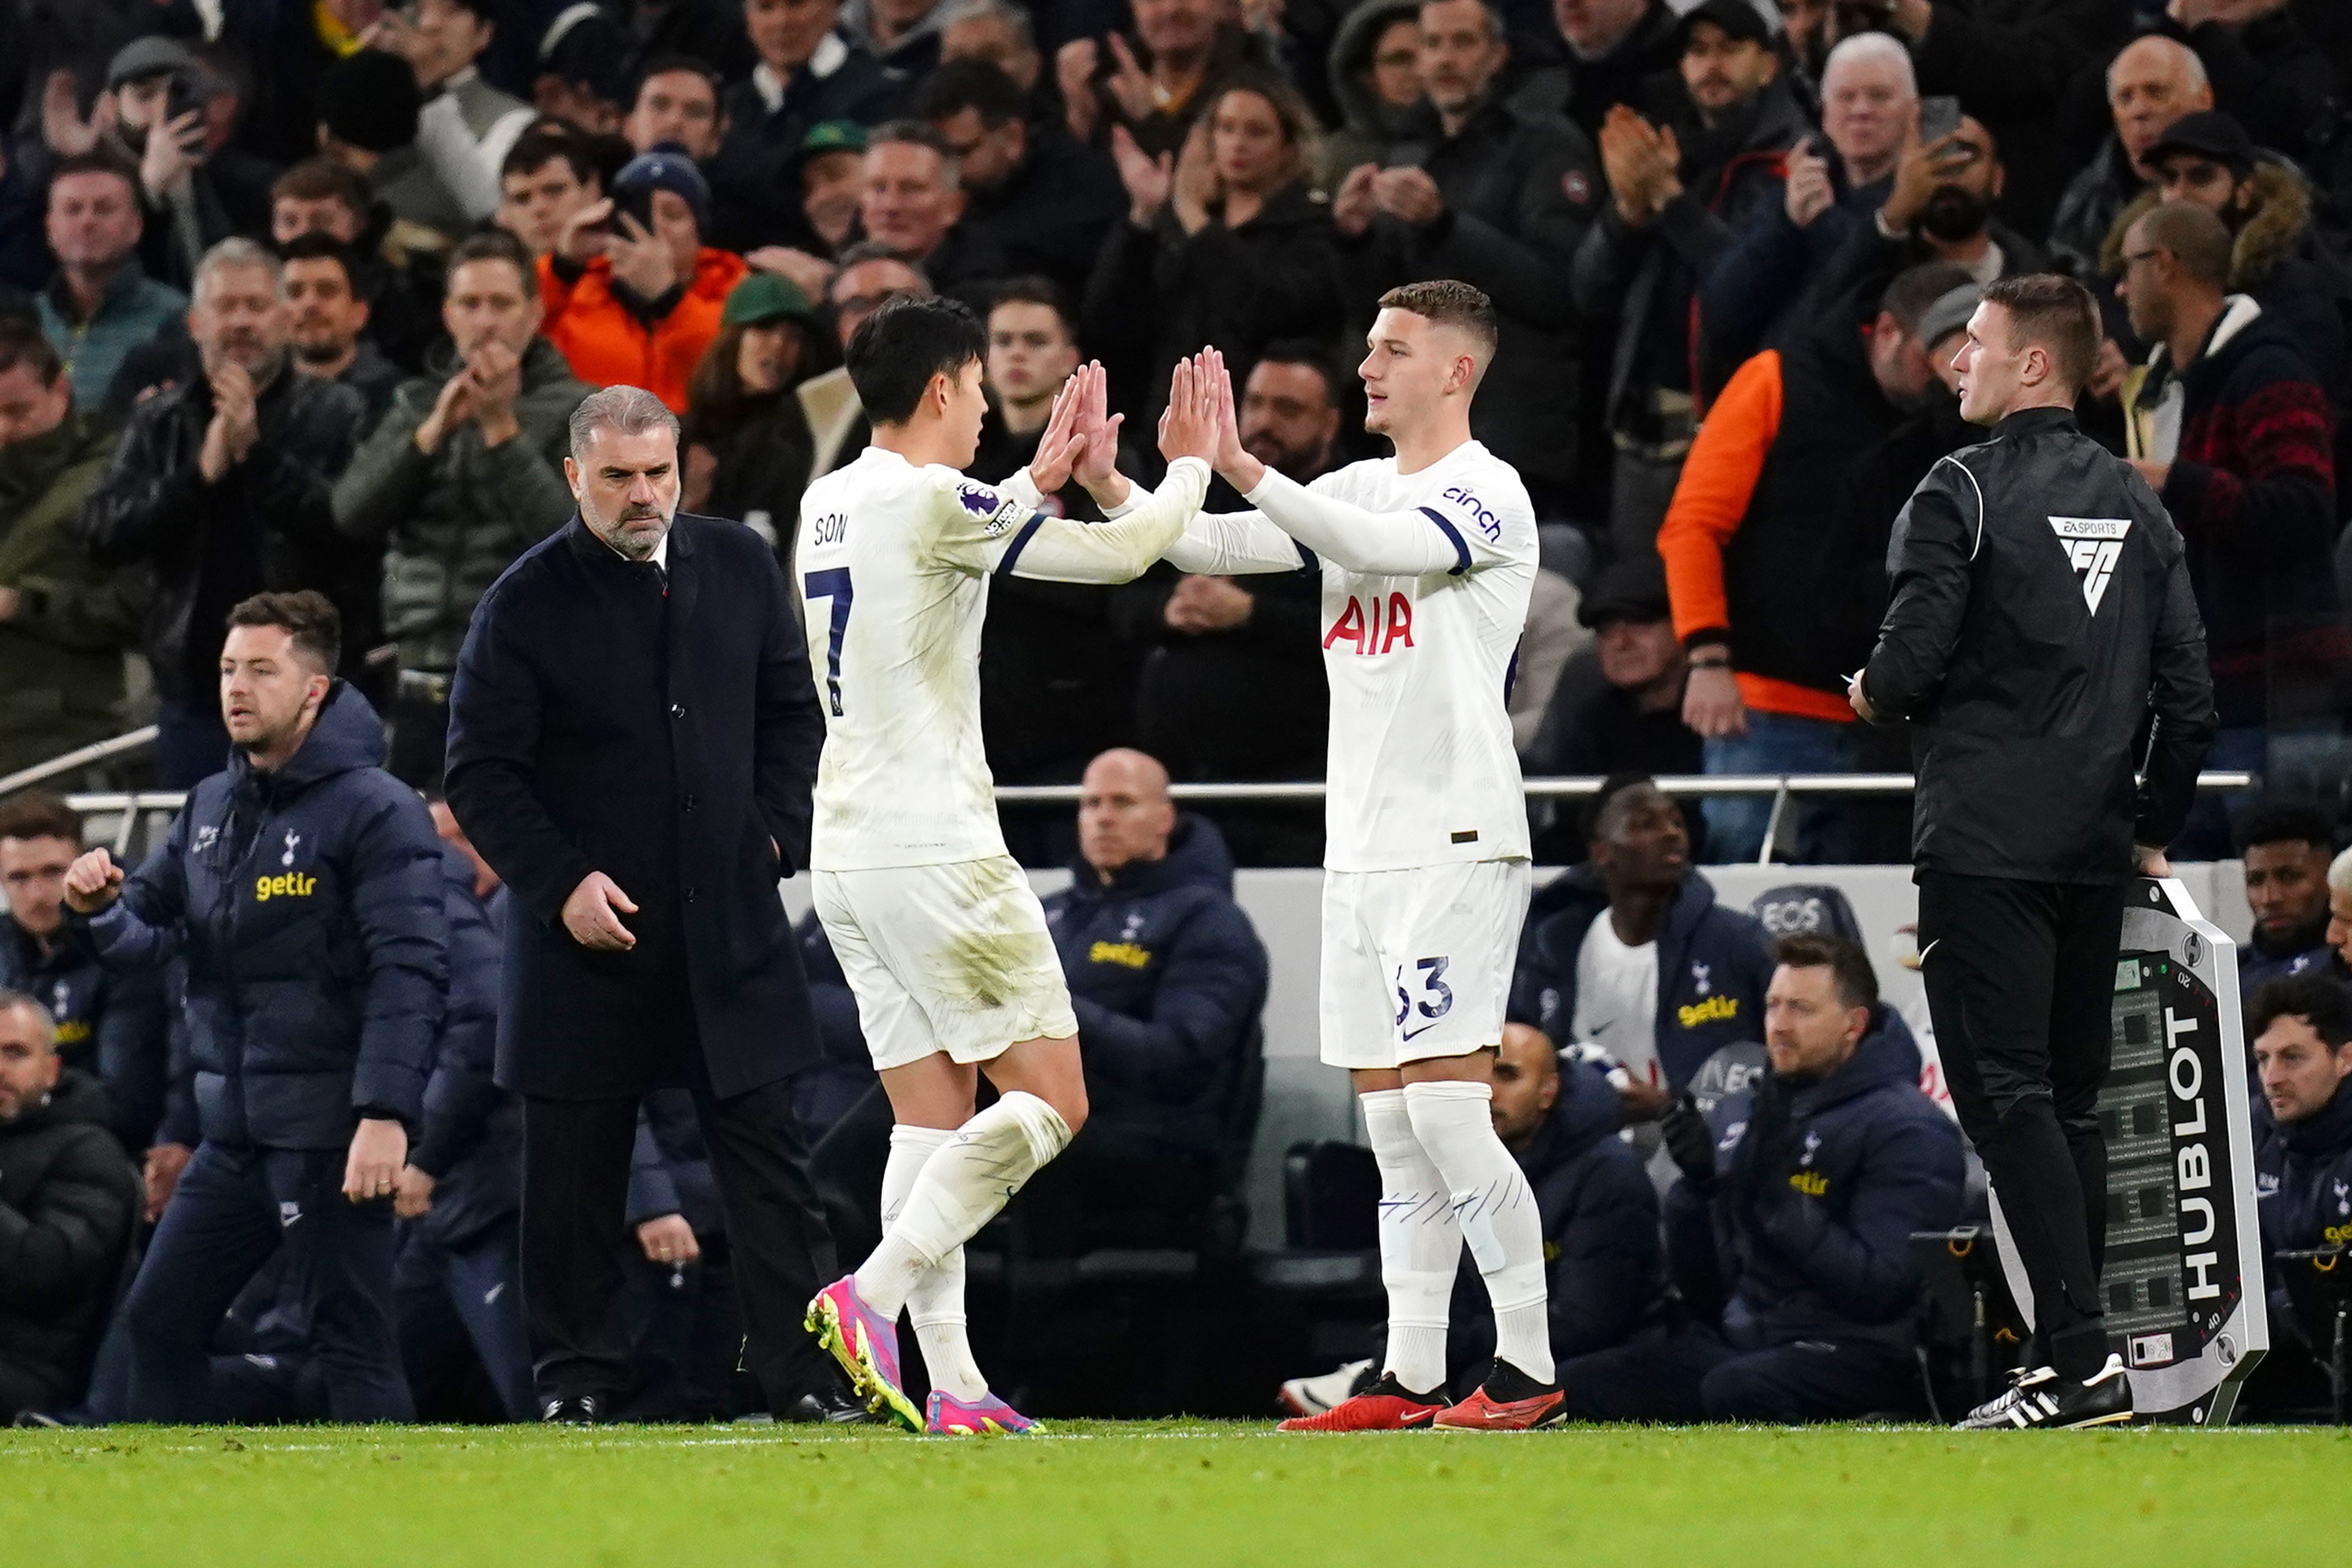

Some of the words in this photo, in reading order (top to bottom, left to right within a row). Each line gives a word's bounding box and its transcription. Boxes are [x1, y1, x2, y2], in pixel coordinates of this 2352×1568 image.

[814, 513, 849, 546] SON
[1442, 488, 1501, 543] cinch
[2078, 522, 2117, 535] SPORTS
[804, 566, 853, 716] 7
[1323, 591, 1414, 655] AIA
[256, 871, 317, 902] getir
[2165, 1007, 2221, 1301] HUBLOT
